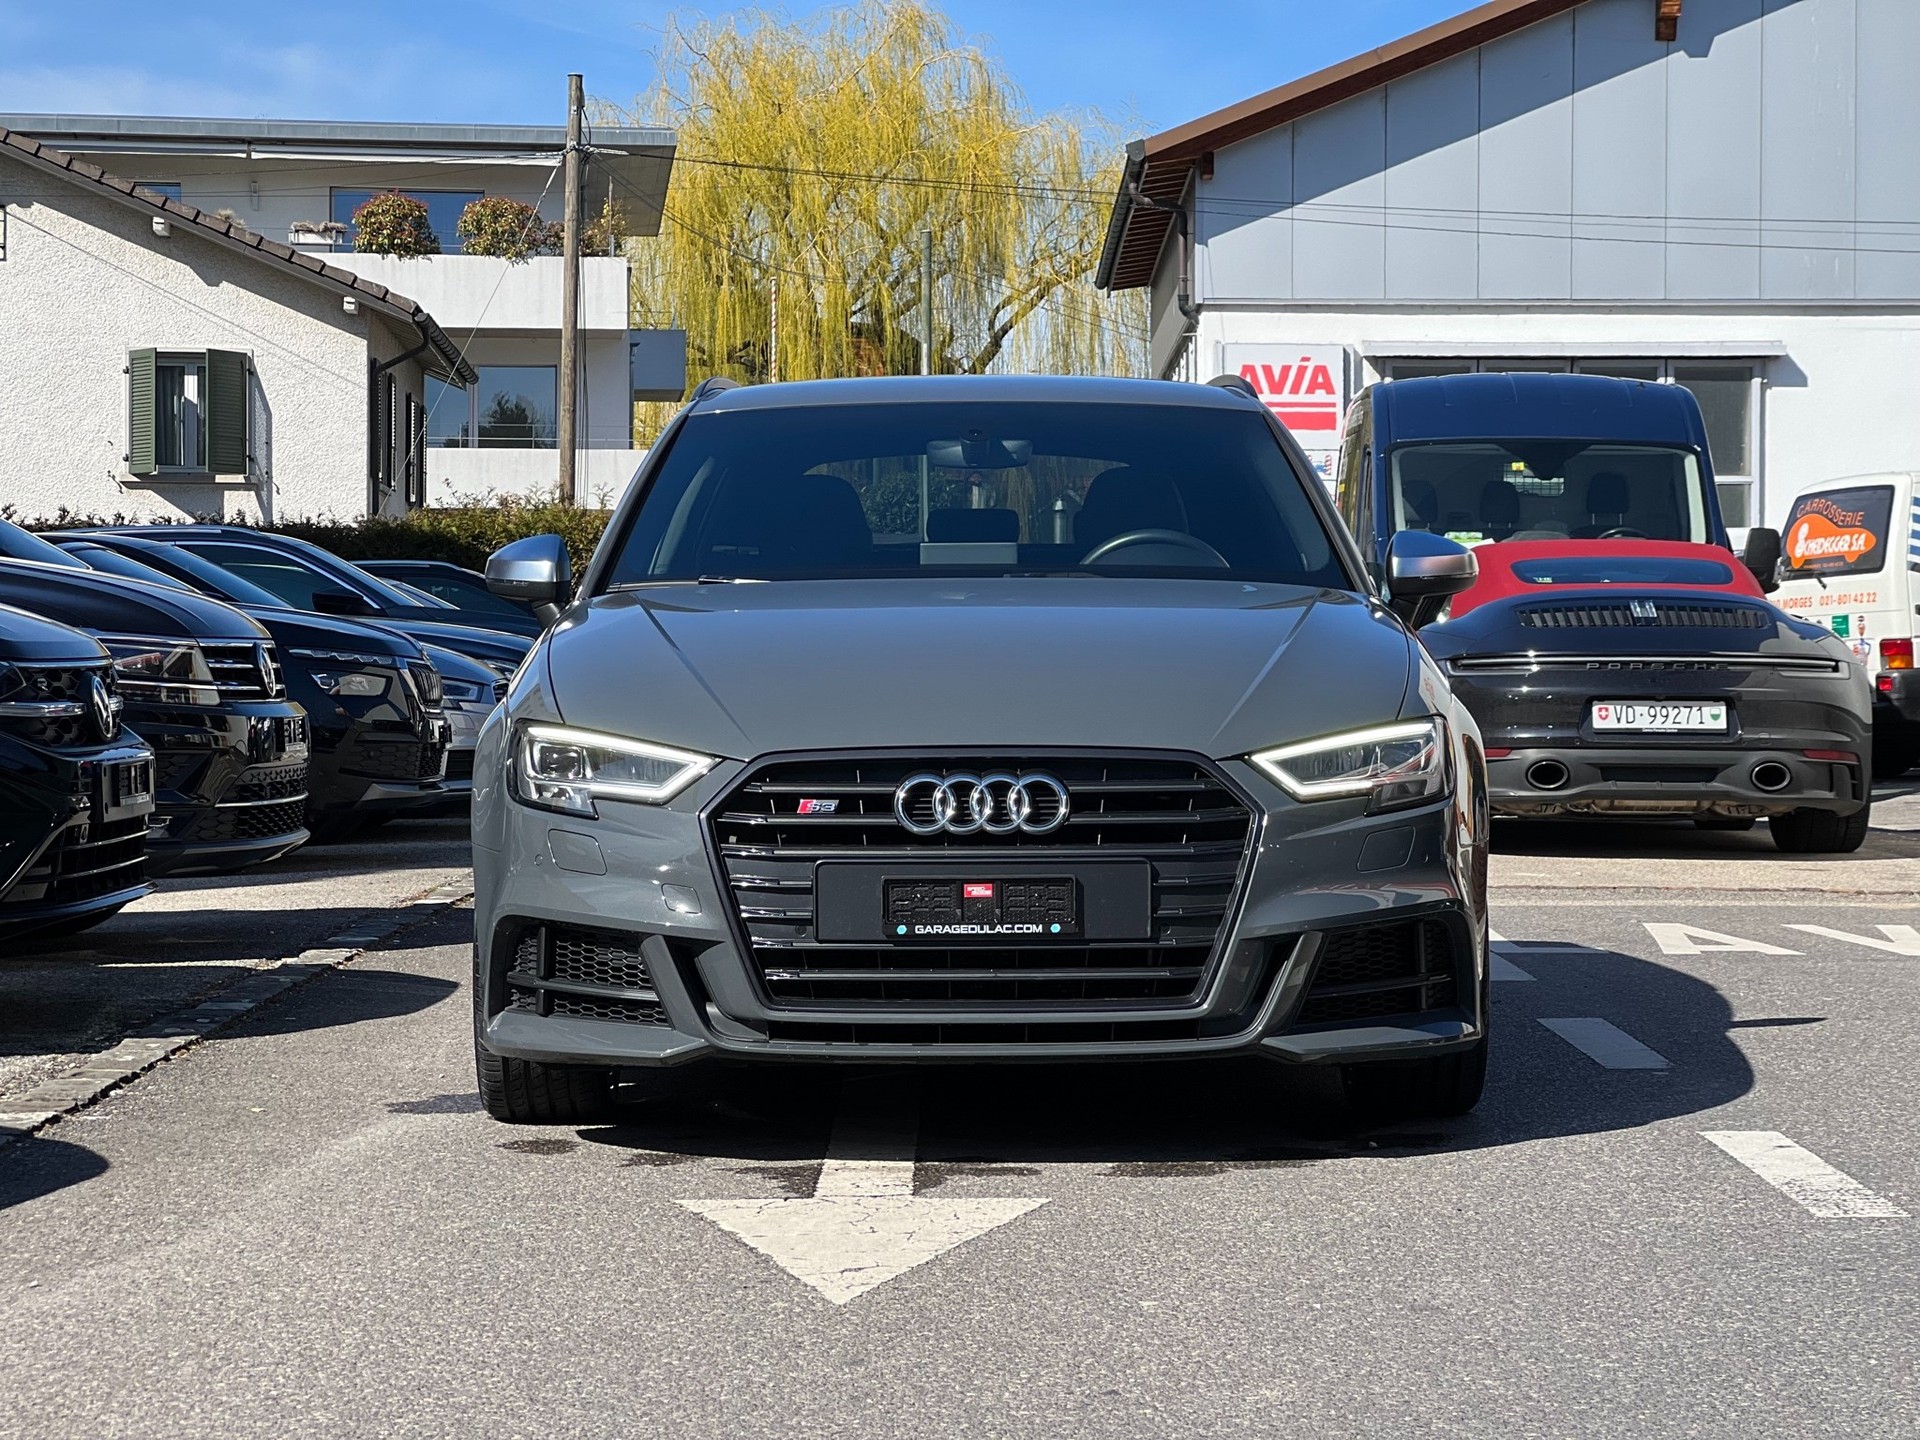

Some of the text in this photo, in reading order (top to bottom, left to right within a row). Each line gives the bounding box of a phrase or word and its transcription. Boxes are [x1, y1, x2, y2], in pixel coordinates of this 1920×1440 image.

[1796, 498, 1865, 526] CARROSSERIE
[1782, 596, 1813, 609] MORGES
[1586, 661, 1729, 671] PORSCHE
[806, 801, 836, 812] S3
[914, 923, 1043, 934] GARAGEDULAC.COM
